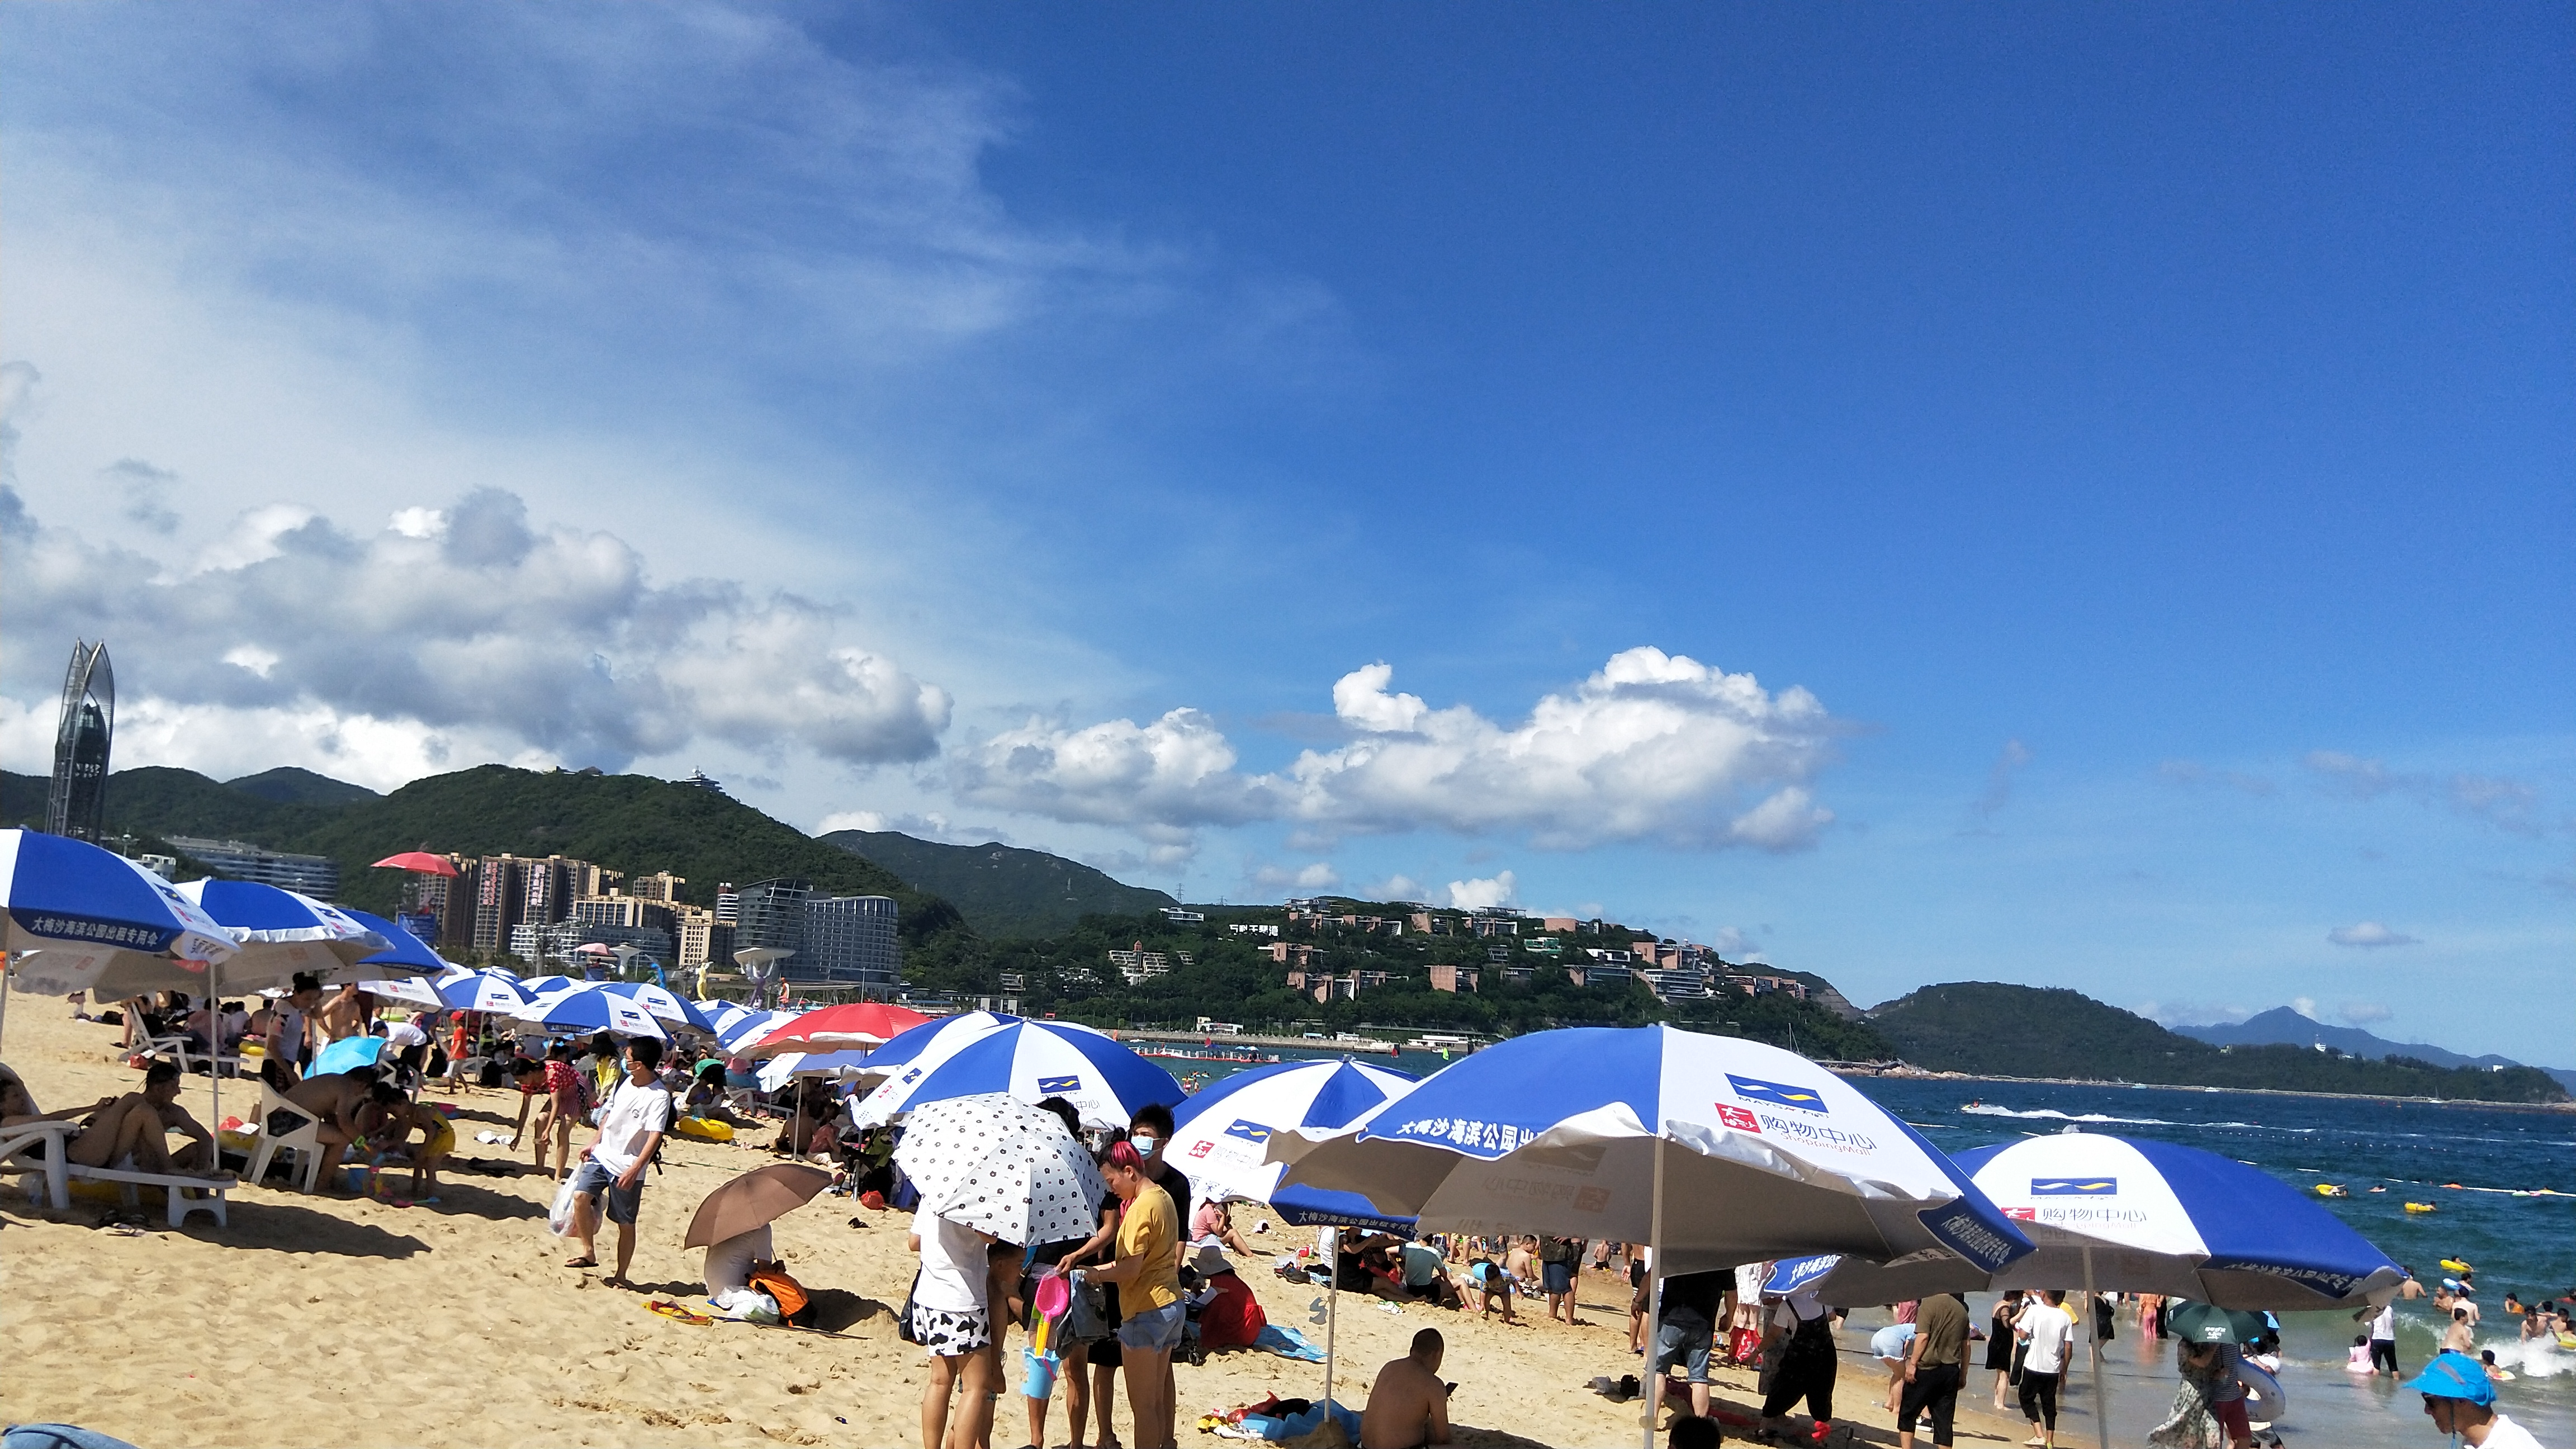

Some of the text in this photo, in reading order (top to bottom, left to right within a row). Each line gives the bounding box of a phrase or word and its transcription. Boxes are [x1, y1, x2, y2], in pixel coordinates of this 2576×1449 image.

[31, 916, 159, 948] 大梅沙海滨公园出租专用伞
[1070, 1099, 1101, 1110] 中心
[1396, 1117, 1546, 1152] 大梅沙海滨公园出
[1760, 1114, 1877, 1150] 购物中心
[2043, 1208, 2147, 1222] 购物中心
[1789, 1254, 1841, 1285] 大梅沙海滨公
